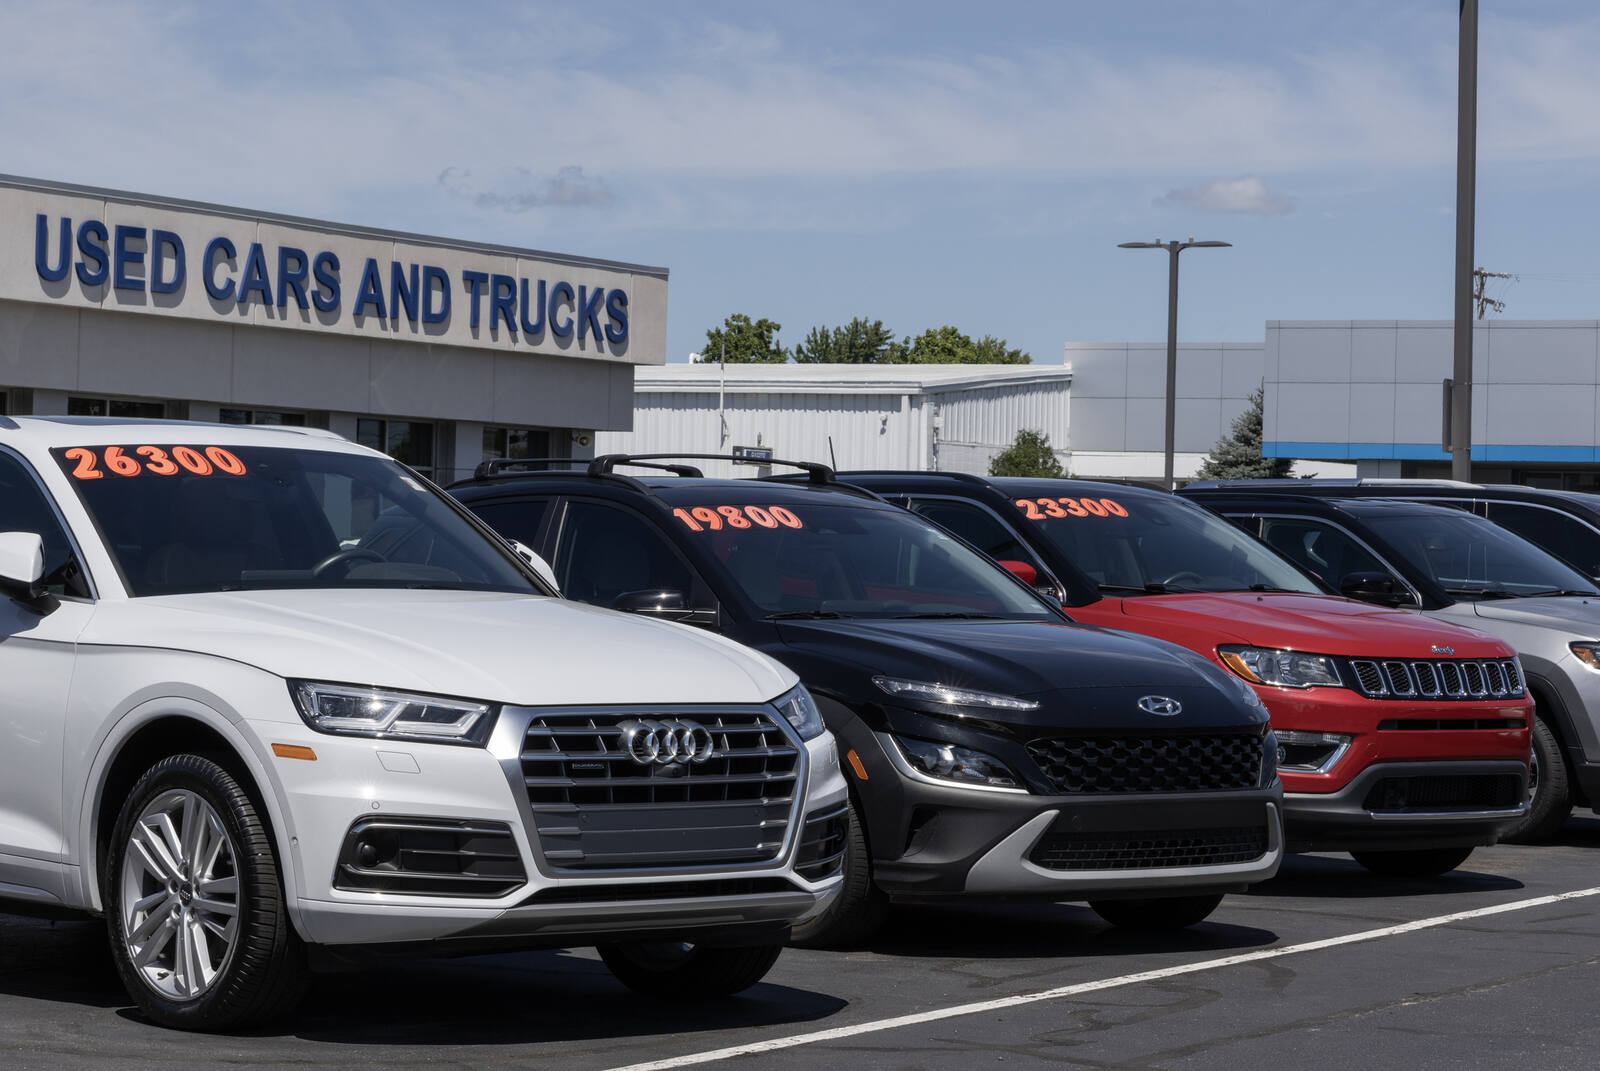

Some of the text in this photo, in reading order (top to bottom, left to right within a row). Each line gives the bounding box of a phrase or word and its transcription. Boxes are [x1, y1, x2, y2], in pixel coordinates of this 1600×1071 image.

[35, 214, 629, 343] USED CARS AND TRUCKS
[65, 445, 247, 480] 26300
[673, 505, 803, 531] 19800
[1015, 497, 1129, 520] 23300
